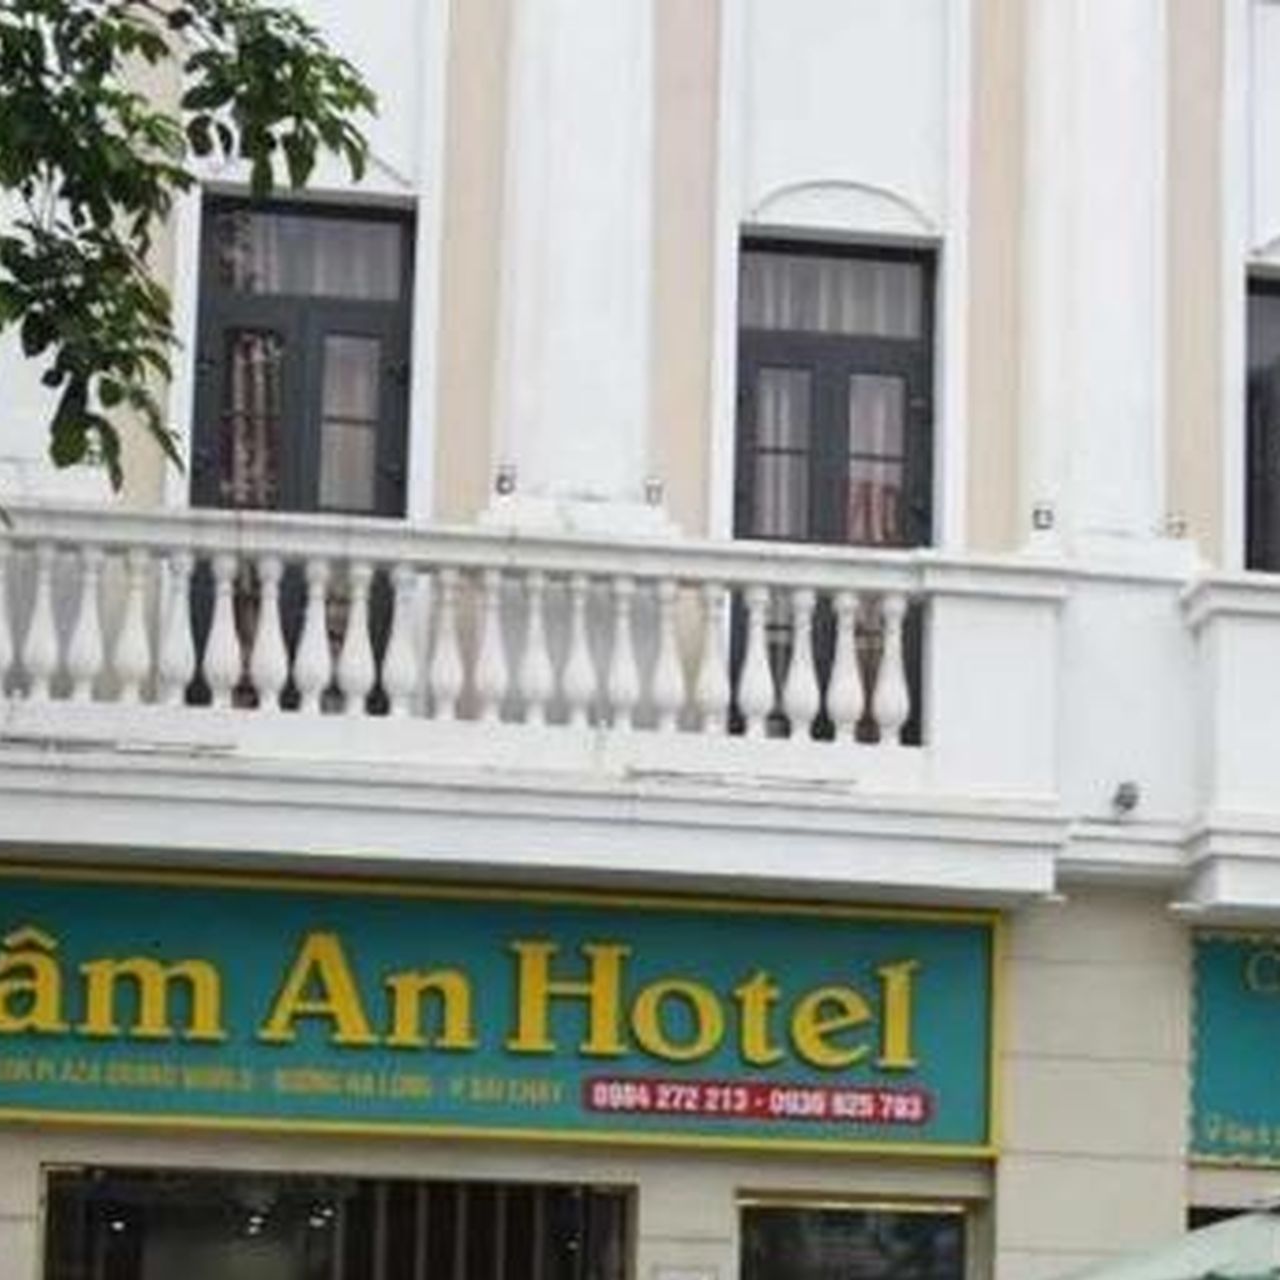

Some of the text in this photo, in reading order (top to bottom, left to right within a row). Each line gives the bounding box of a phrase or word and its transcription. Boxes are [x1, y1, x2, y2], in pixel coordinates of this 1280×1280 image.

[258, 929, 478, 1048] An
[507, 939, 920, 1072] Hotel
[655, 1083, 700, 1112] 272
[705, 1085, 749, 1113] 213
